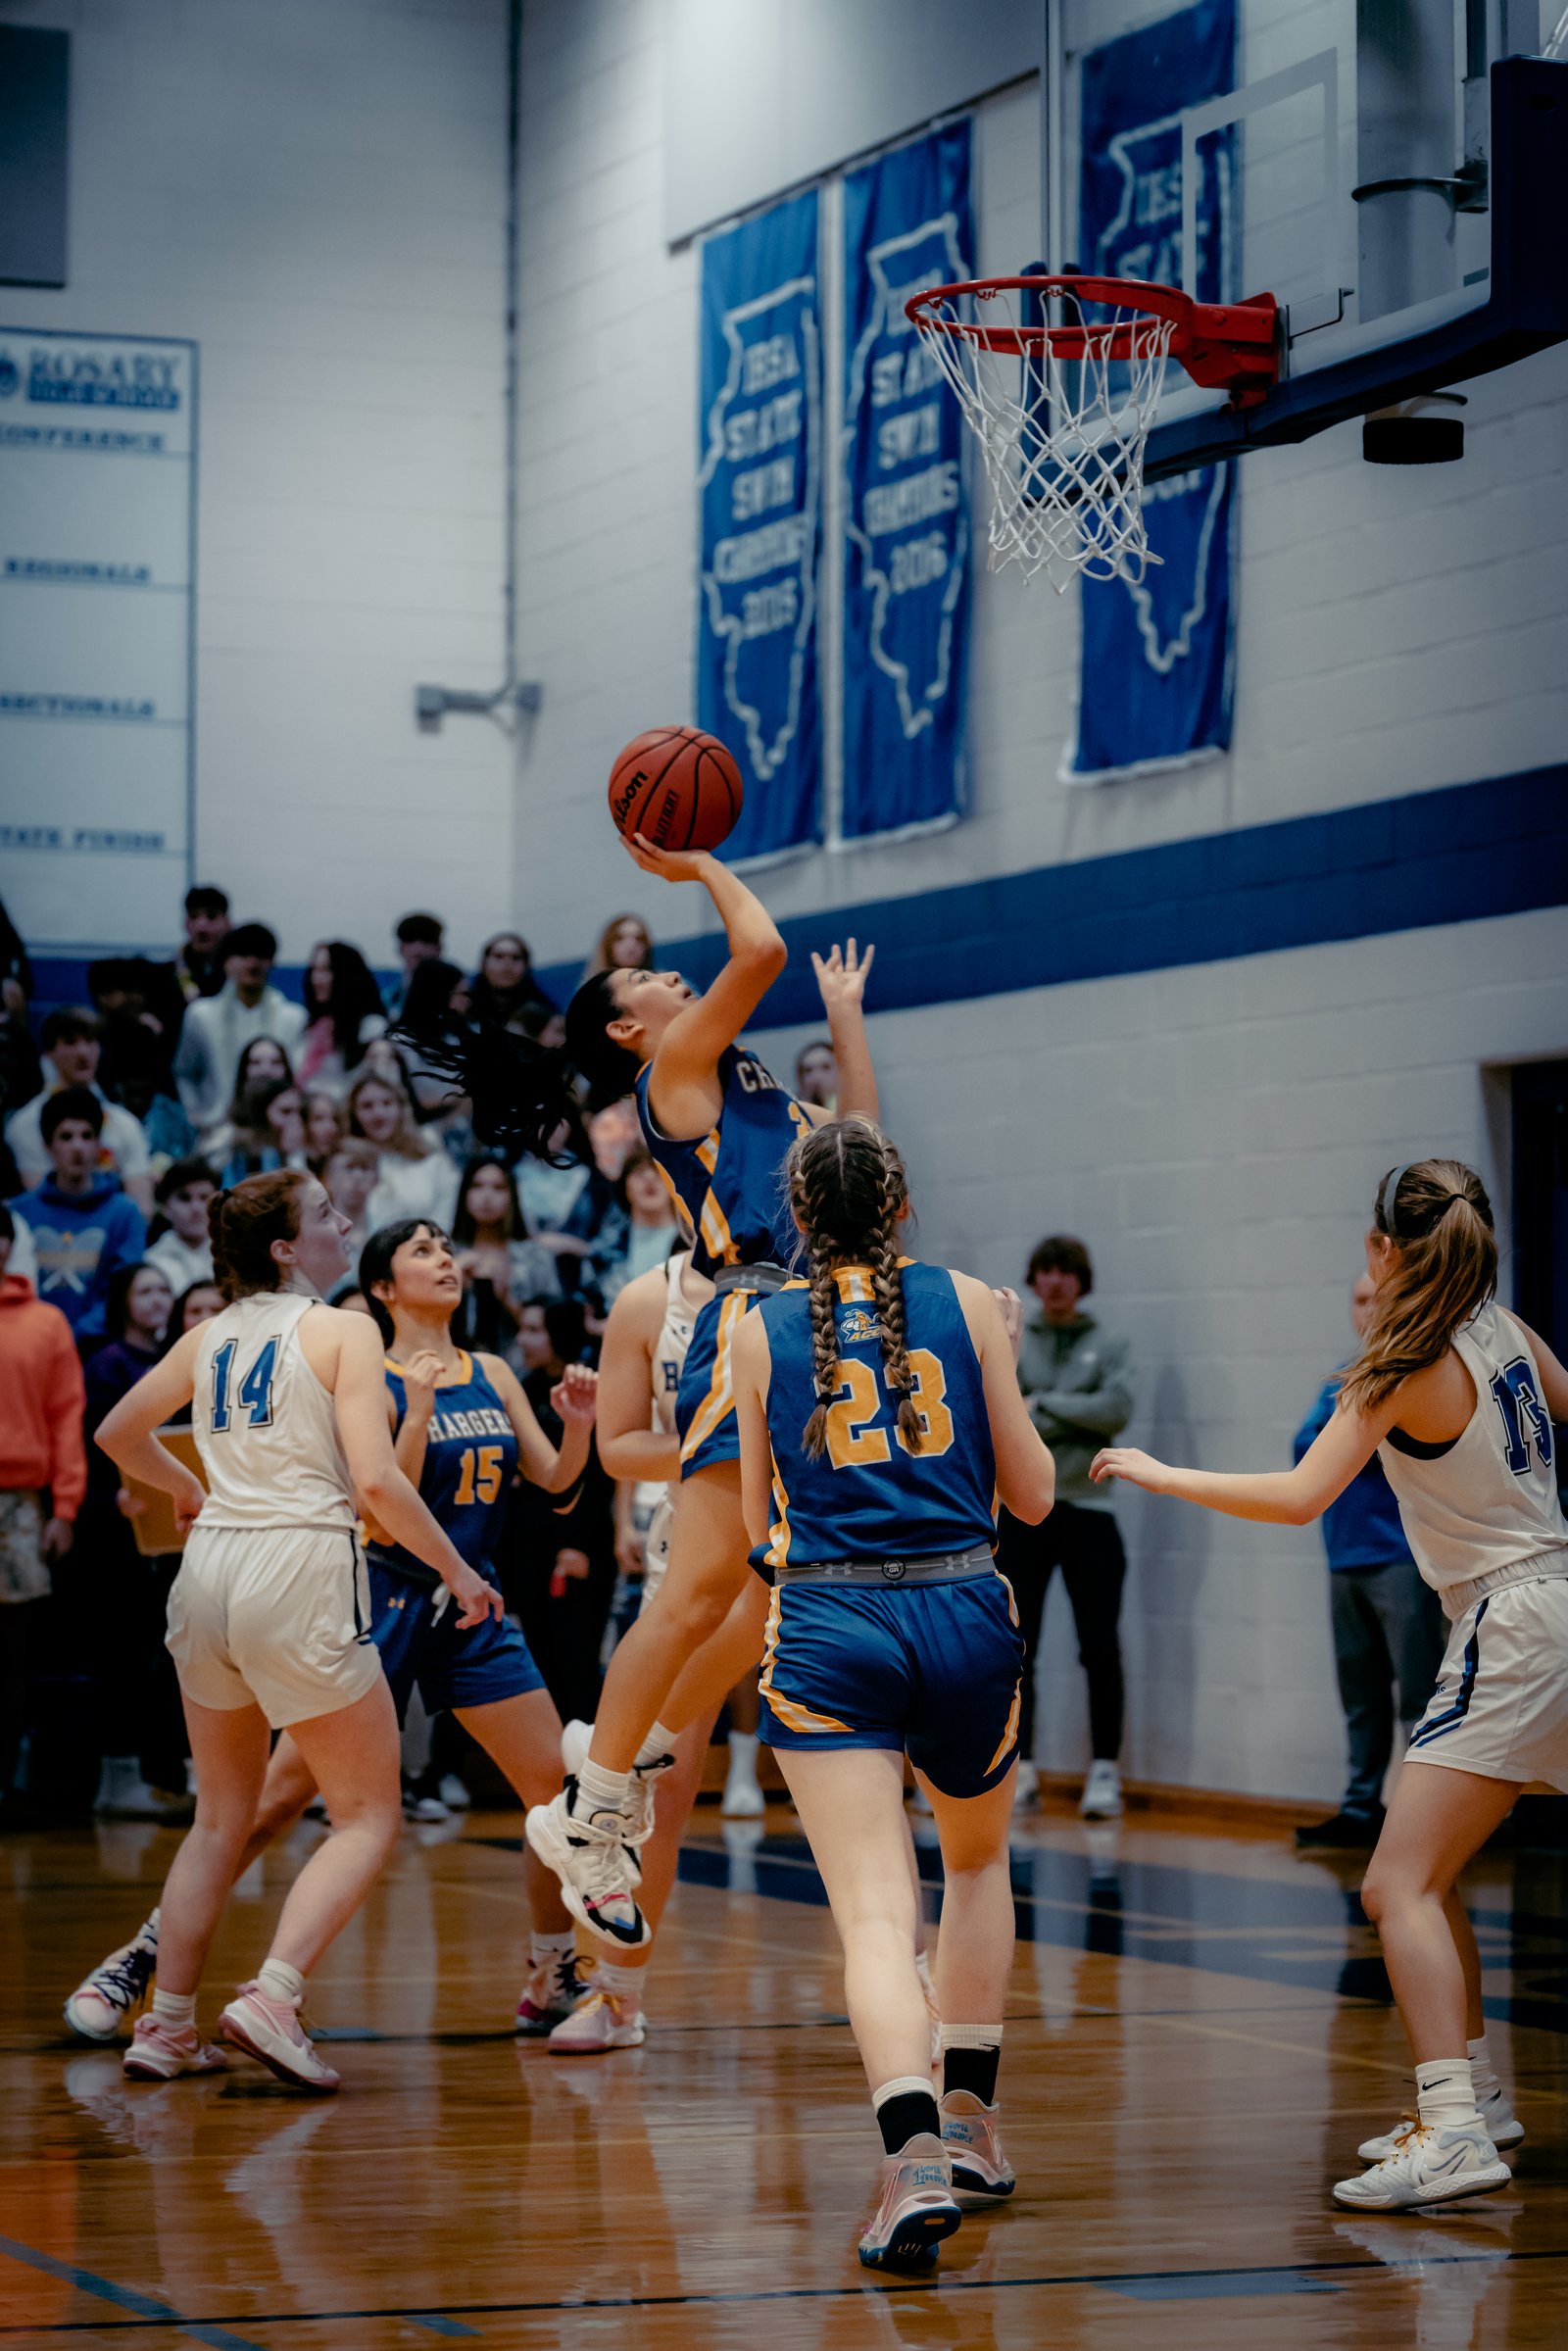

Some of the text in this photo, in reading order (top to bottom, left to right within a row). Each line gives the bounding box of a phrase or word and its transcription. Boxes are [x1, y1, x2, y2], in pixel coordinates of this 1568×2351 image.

[28, 347, 180, 390] ROSARY
[0, 422, 165, 453] ONFERENCE
[211, 1334, 282, 1434] 14
[813, 1347, 955, 1470] 23
[454, 1445, 504, 1505] 15
